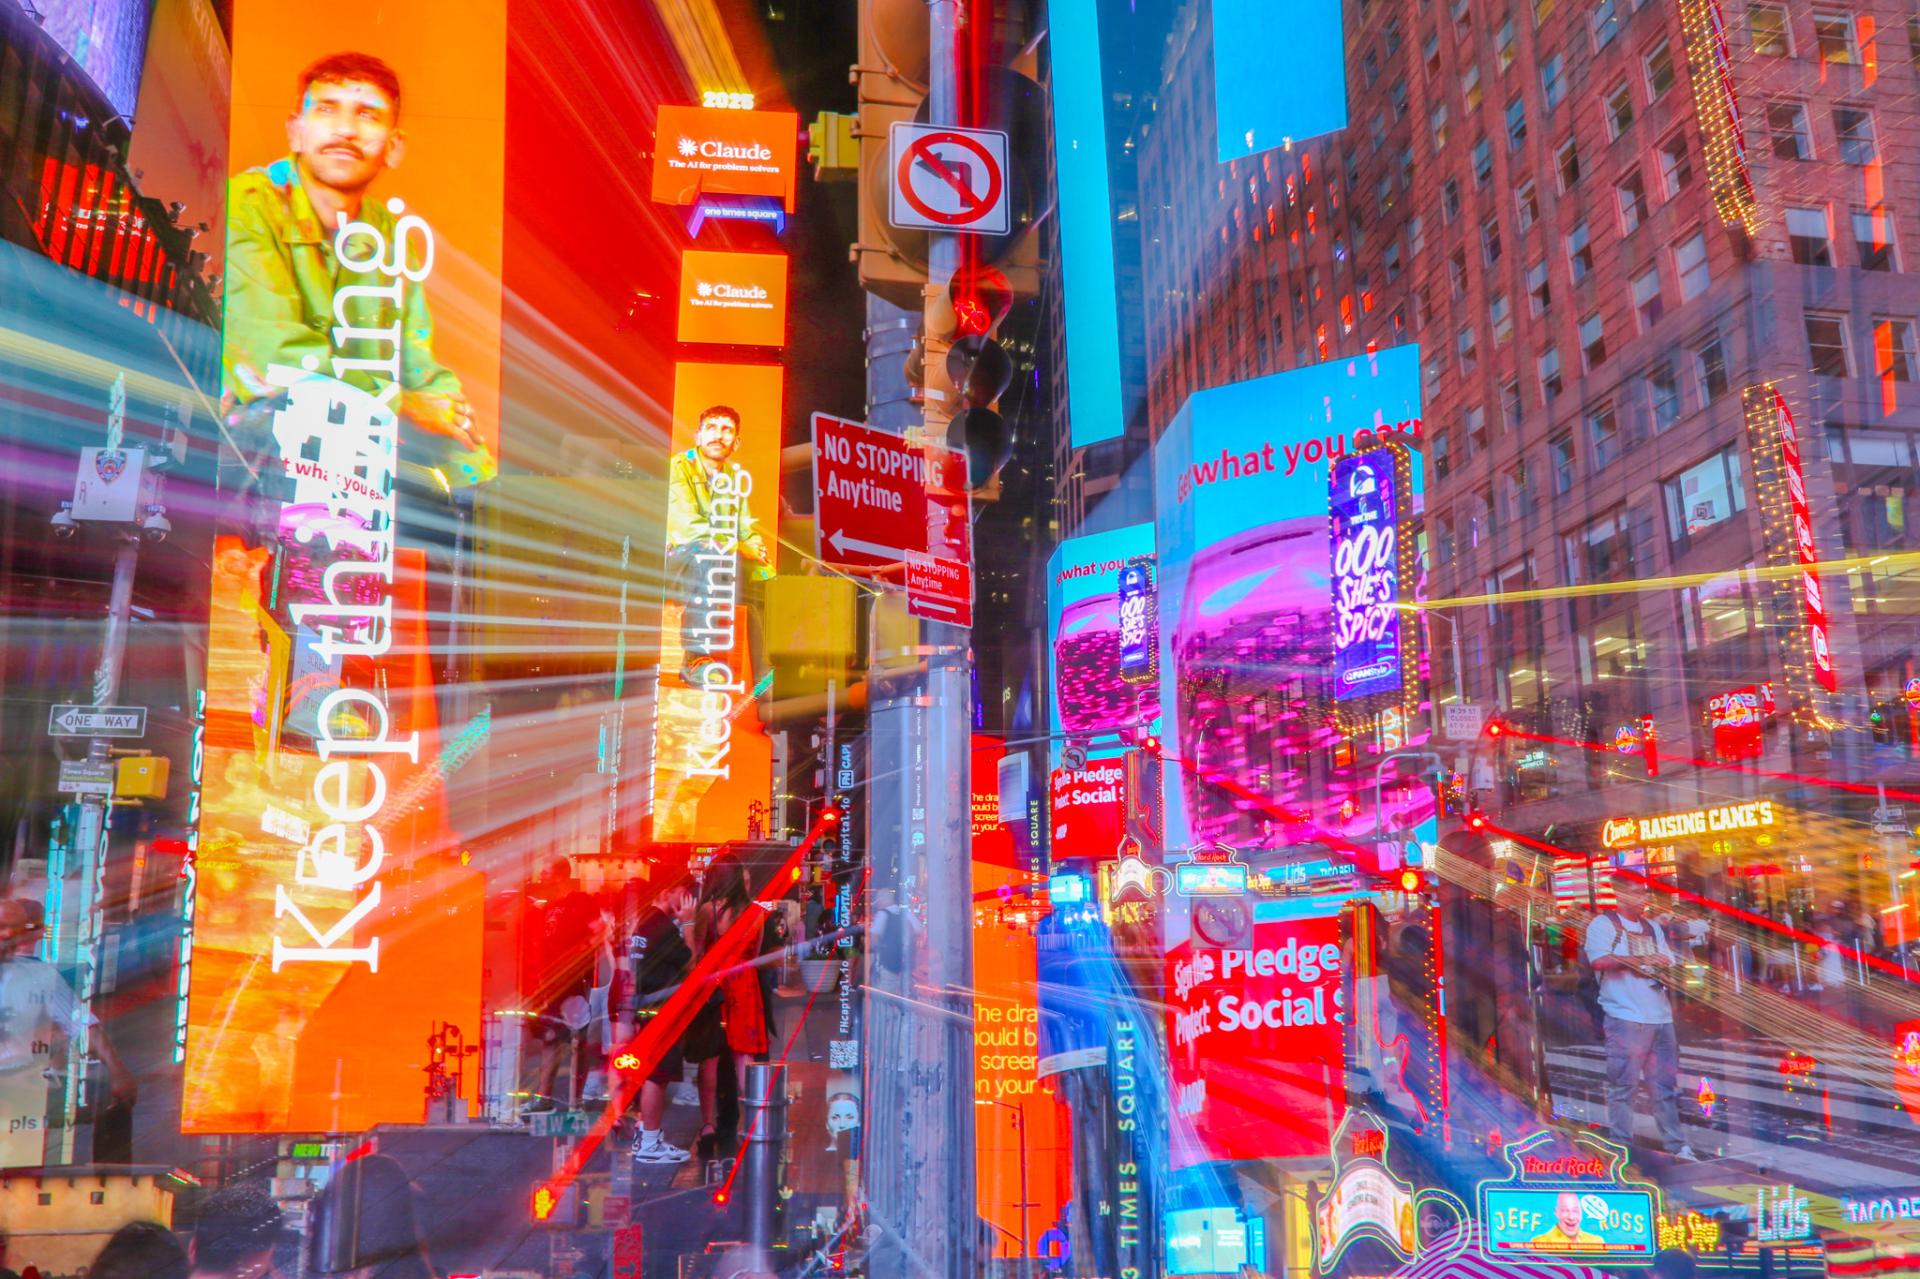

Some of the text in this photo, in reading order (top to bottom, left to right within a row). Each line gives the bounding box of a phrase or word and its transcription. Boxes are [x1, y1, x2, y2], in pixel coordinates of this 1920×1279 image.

[702, 91, 754, 110] 2025
[700, 141, 772, 160] Claude
[668, 159, 780, 173] The AI for problem solvers
[747, 210, 777, 219] square
[713, 284, 767, 299] Claude
[825, 431, 943, 487] NO STOPPING
[1193, 442, 1275, 487] what
[1283, 434, 1345, 475] you
[827, 470, 902, 512] Anytime
[910, 559, 959, 579] NO STOPPING
[1063, 563, 1096, 580] what
[1099, 559, 1124, 575] you
[911, 573, 942, 591] Anytime
[1336, 569, 1393, 614] SHE'S
[687, 463, 753, 780] Keep thinking.
[65, 715, 132, 727] ONE WAY
[1074, 766, 1123, 784] Pledge
[1072, 786, 1117, 805] Social
[272, 687, 419, 973] Keep
[1030, 800, 1039, 846] SQUARE
[1639, 811, 1706, 840] RAISING
[1708, 801, 1774, 831] CANE'S
[1031, 857, 1040, 893] TIMES
[1285, 864, 1306, 884] Lids
[840, 883, 850, 927] CAPITAL
[1222, 937, 1340, 982] Pledge
[1176, 999, 1212, 1047] Protect
[1218, 986, 1327, 1032] Social
[1117, 1020, 1137, 1132] SQUARE
[995, 1079, 1038, 1098] your
[10, 1116, 37, 1133] pls
[1525, 1156, 1604, 1178] Hard Rock
[1119, 1162, 1138, 1249] TIMES
[1758, 1184, 1810, 1240] Lids
[1495, 1208, 1542, 1231] JEFF
[1599, 1209, 1644, 1233] ROSS
